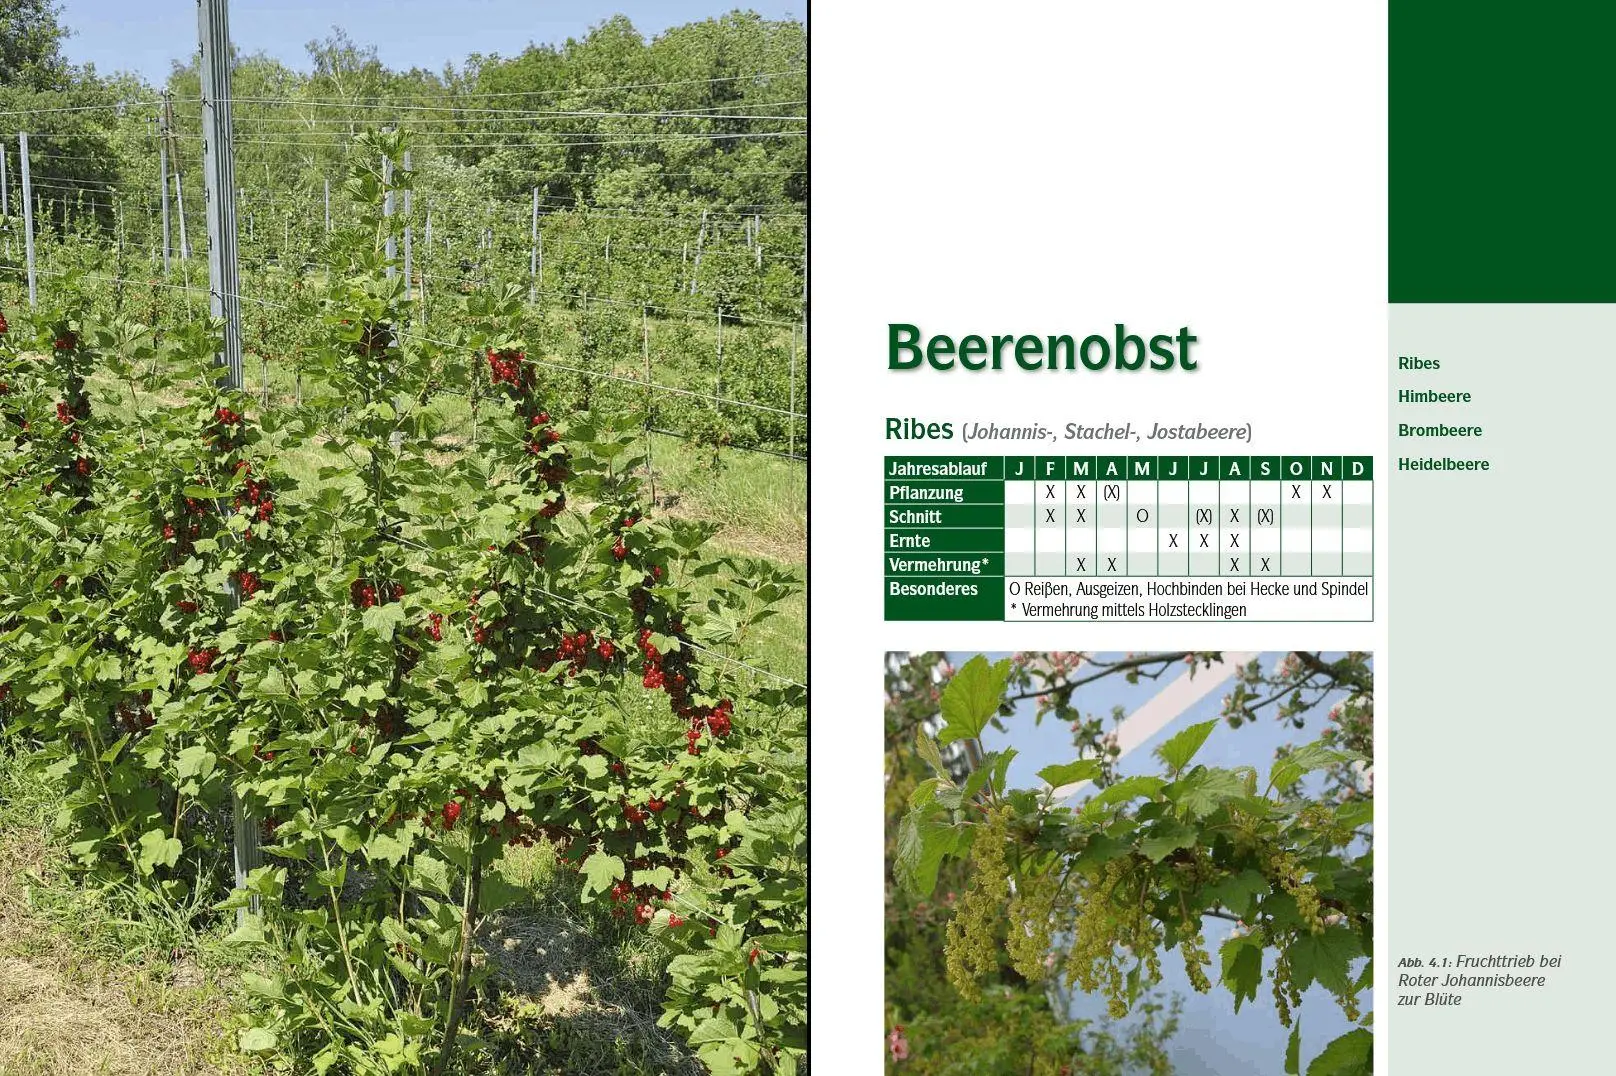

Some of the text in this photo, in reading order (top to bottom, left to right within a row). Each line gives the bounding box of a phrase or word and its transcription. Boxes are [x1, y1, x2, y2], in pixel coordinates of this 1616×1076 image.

[888, 324, 1197, 372] Beerenobst
[1398, 357, 1440, 369] Ribes
[1398, 390, 1471, 402] Himbeere
[885, 418, 1251, 443] Ribes (Johannis-, Stachel-, Jostabeere)
[1398, 424, 1482, 436] Brombeere
[888, 462, 1363, 475] Jahresablauf J F M A M J J A S O N D
[1398, 458, 1489, 470] Heidelbeere
[889, 485, 1331, 503] Pflanzung X X (X) X X
[889, 509, 1273, 525] Schnitt X X O (X) X (X)
[889, 534, 1239, 547] Ernte X X X
[1076, 558, 1085, 571] X
[1107, 558, 1116, 571] X
[1229, 558, 1239, 571] X
[1260, 558, 1270, 571] X
[889, 582, 978, 595] Besonderes
[1009, 582, 1020, 595] O
[1075, 582, 1142, 598] Ausgeizen,
[1147, 582, 1222, 595] Hochbinden
[1227, 582, 1245, 595] bei
[1250, 582, 1289, 595] Hecke
[1293, 582, 1317, 595] und
[1321, 582, 1367, 598] Spindel
[1021, 603, 1098, 619] Vermehrung
[1102, 603, 1144, 616] mittels
[1149, 603, 1246, 619] Holzstecklingen
[1397, 955, 1561, 967] Abb. 4.1: Fruchttrieb bei
[1398, 974, 1545, 986] Roter Johannisbeere
[1397, 993, 1461, 1005] zur Blüte
